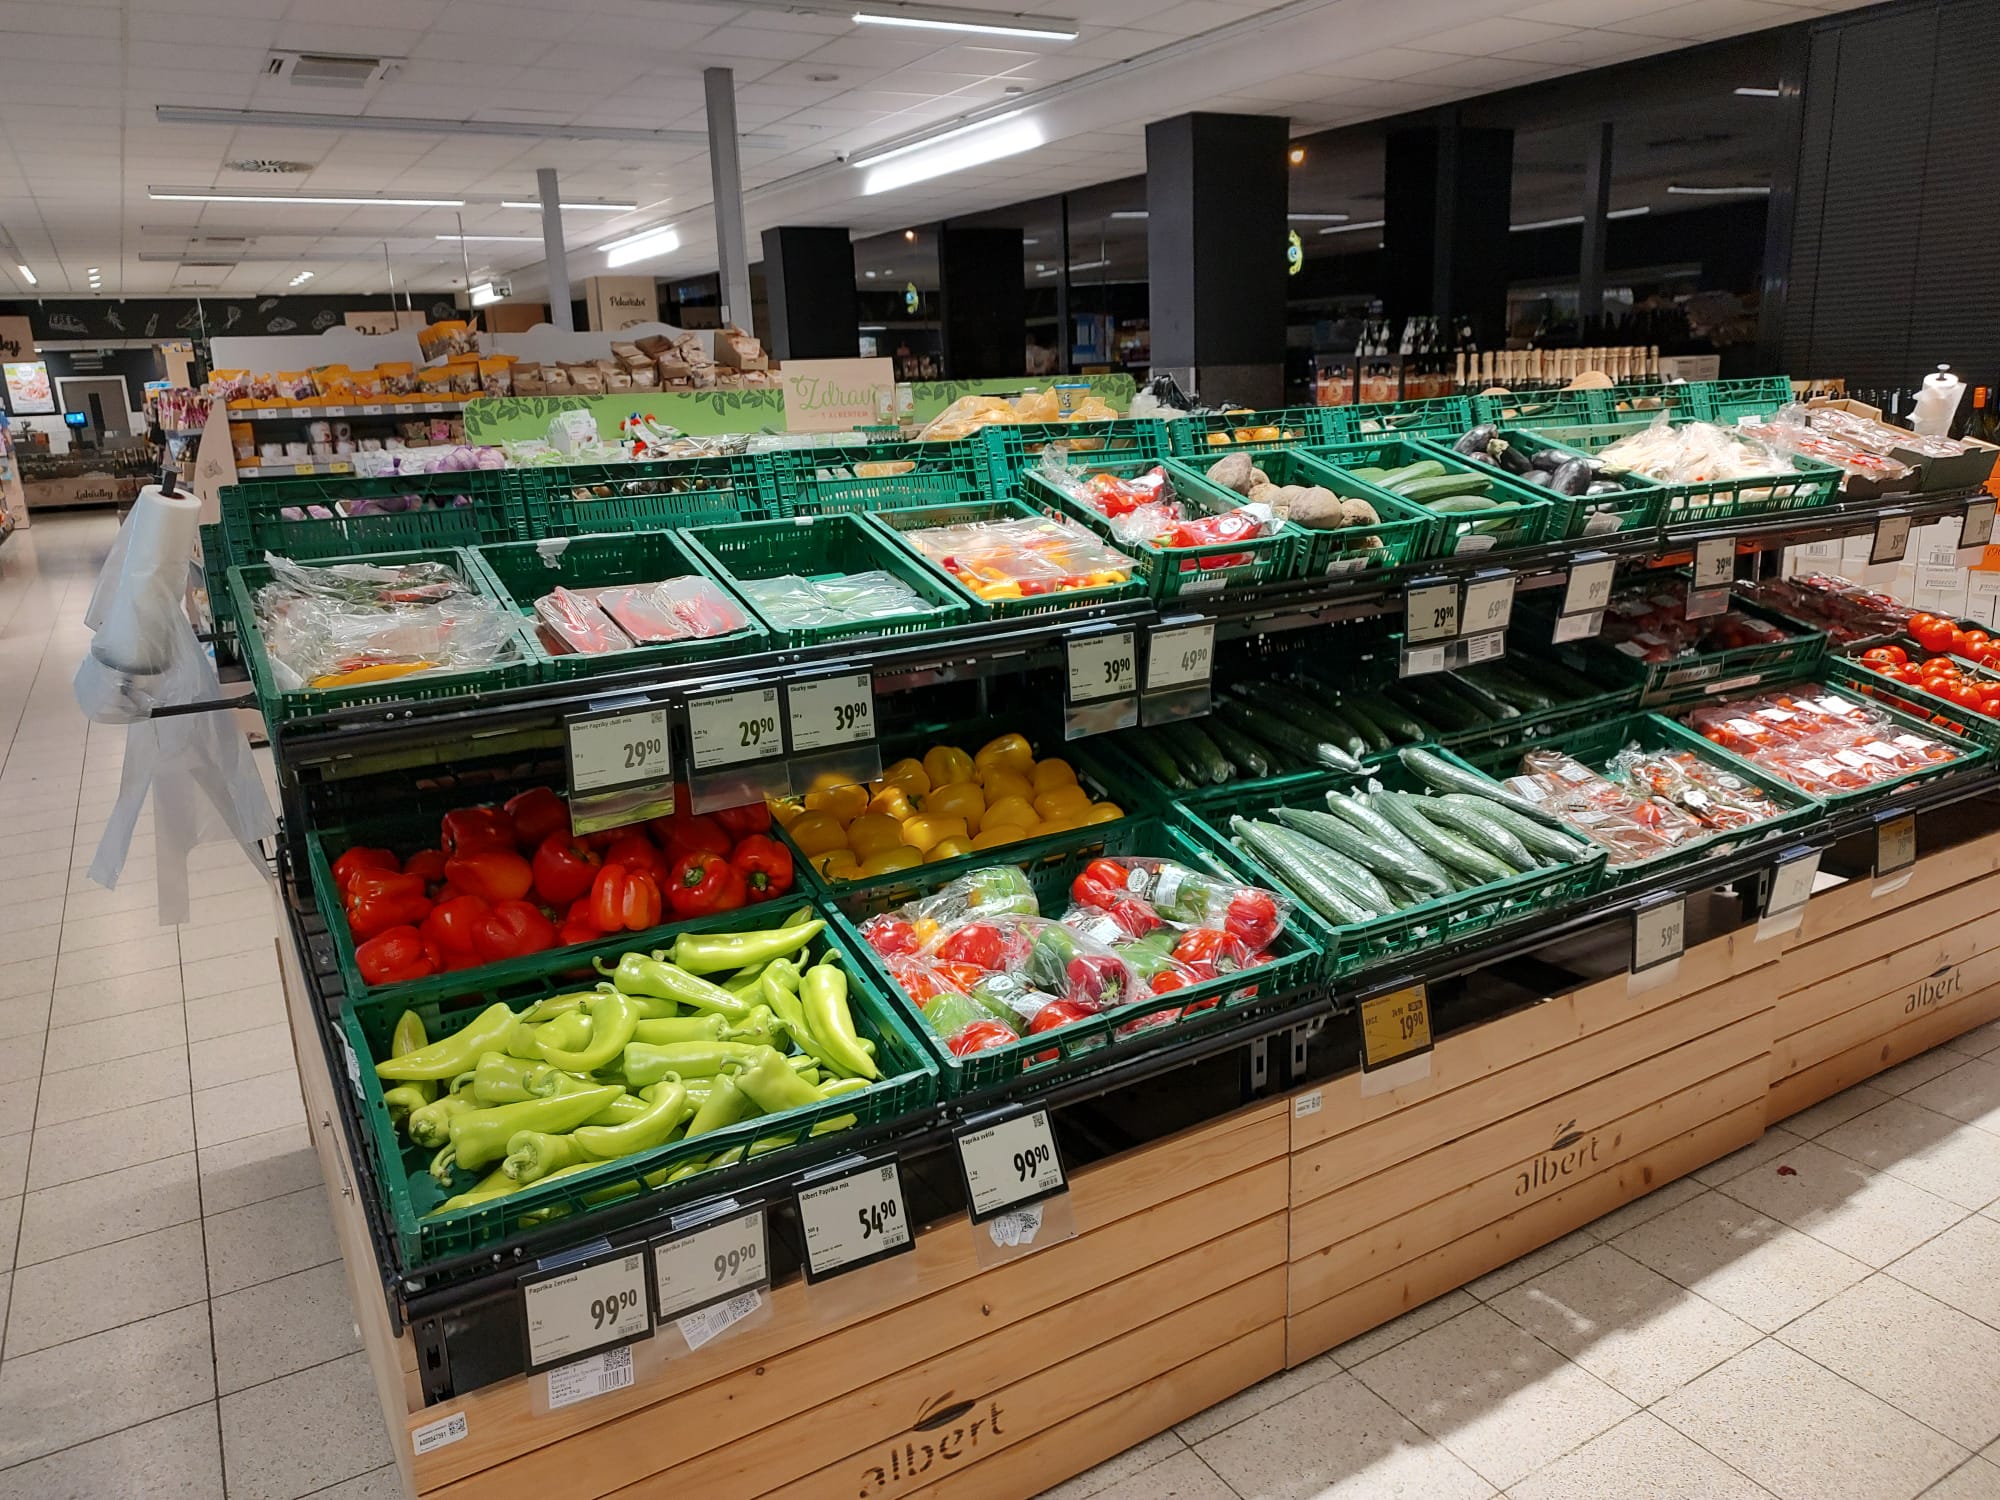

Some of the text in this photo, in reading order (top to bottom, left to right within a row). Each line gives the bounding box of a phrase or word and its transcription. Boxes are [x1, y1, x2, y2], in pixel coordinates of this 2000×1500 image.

[1904, 967, 1961, 1014] albert
[961, 1136, 980, 1146] Paprika
[1515, 1137, 1599, 1197] albert
[801, 1190, 818, 1201] Albert
[818, 1185, 839, 1196] Paprika
[528, 1283, 553, 1295] Paprika
[859, 1402, 1005, 1499] albert
